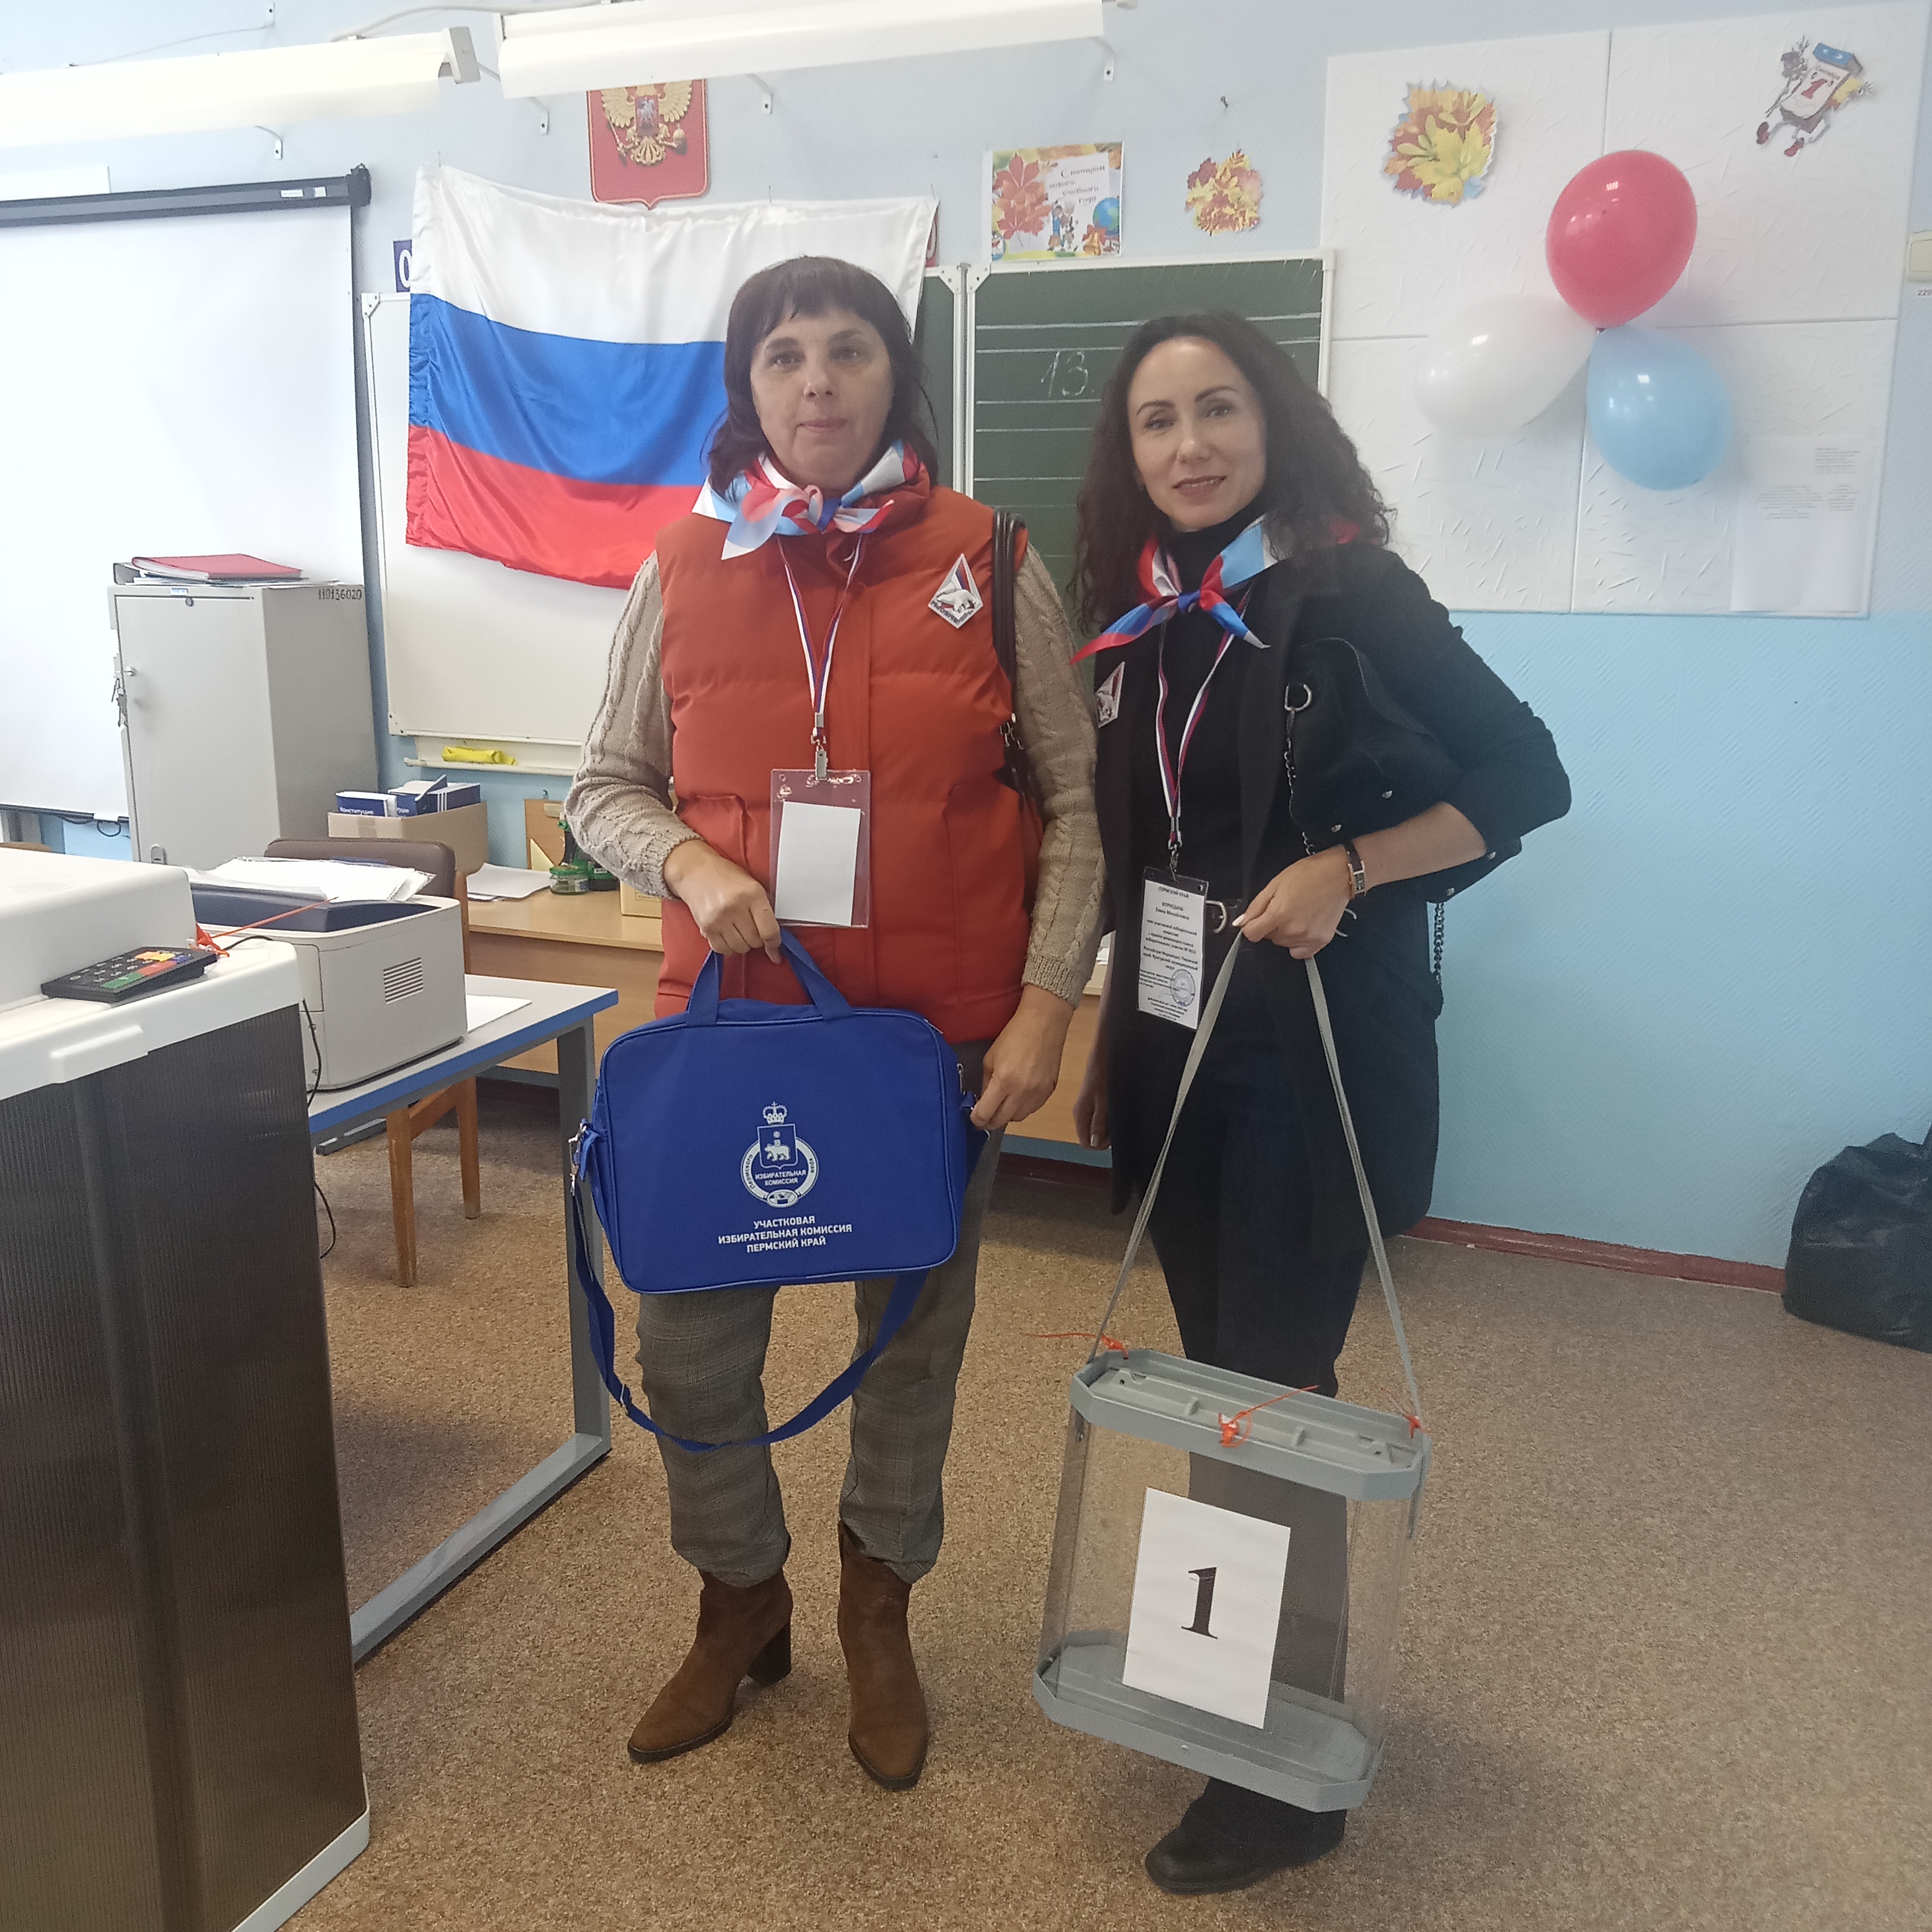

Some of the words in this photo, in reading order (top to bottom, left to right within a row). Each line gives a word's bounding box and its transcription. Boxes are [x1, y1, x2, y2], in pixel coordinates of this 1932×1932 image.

[755, 1169, 806, 1180] ИЗБИРАТЕЛЬНАЯ
[765, 1177, 798, 1186] КОМИССИЯ
[754, 1216, 816, 1229] УЧАСТКОВАЯ
[718, 1228, 798, 1244] ИЗБИРАТЕЛЬНАЯ
[800, 1224, 852, 1236] КОМИССИЯ
[746, 1238, 799, 1253] ПЕРМСКИЙ
[801, 1235, 826, 1247] КРАЙ
[1181, 1567, 1218, 1640] 1
